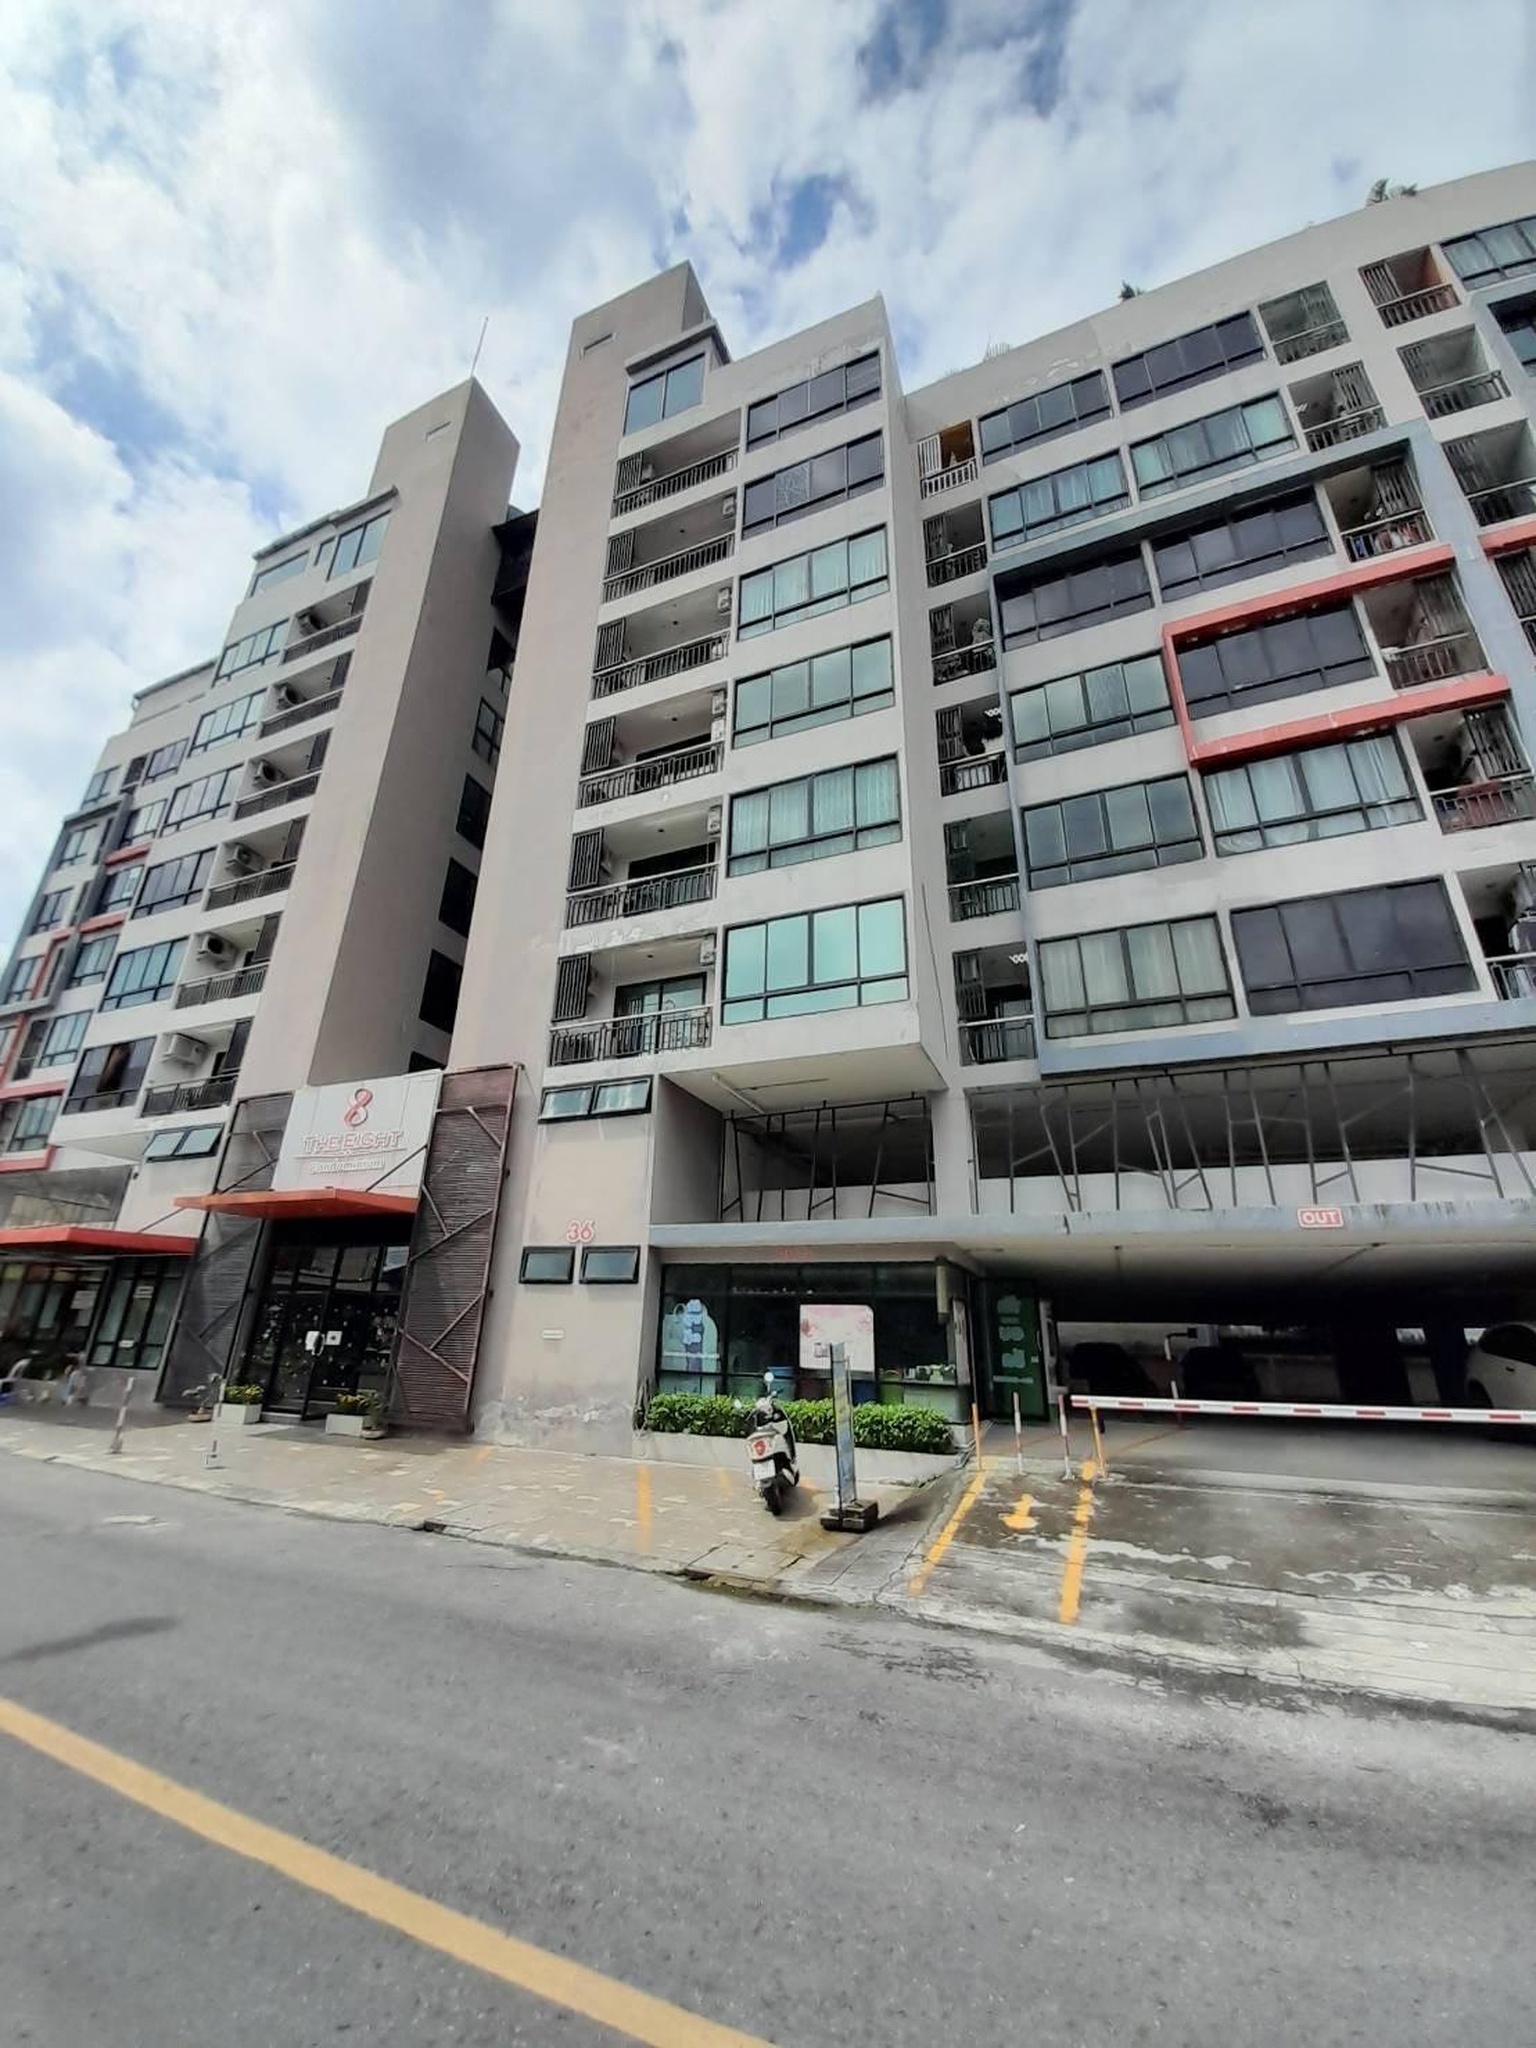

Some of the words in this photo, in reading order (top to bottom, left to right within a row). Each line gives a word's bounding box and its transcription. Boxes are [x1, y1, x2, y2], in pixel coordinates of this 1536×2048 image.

[344, 1088, 373, 1127] 8
[304, 1135, 339, 1155] THE
[343, 1130, 402, 1150] EIGHT
[1302, 1211, 1339, 1224] OUT
[566, 1220, 595, 1244] 36
